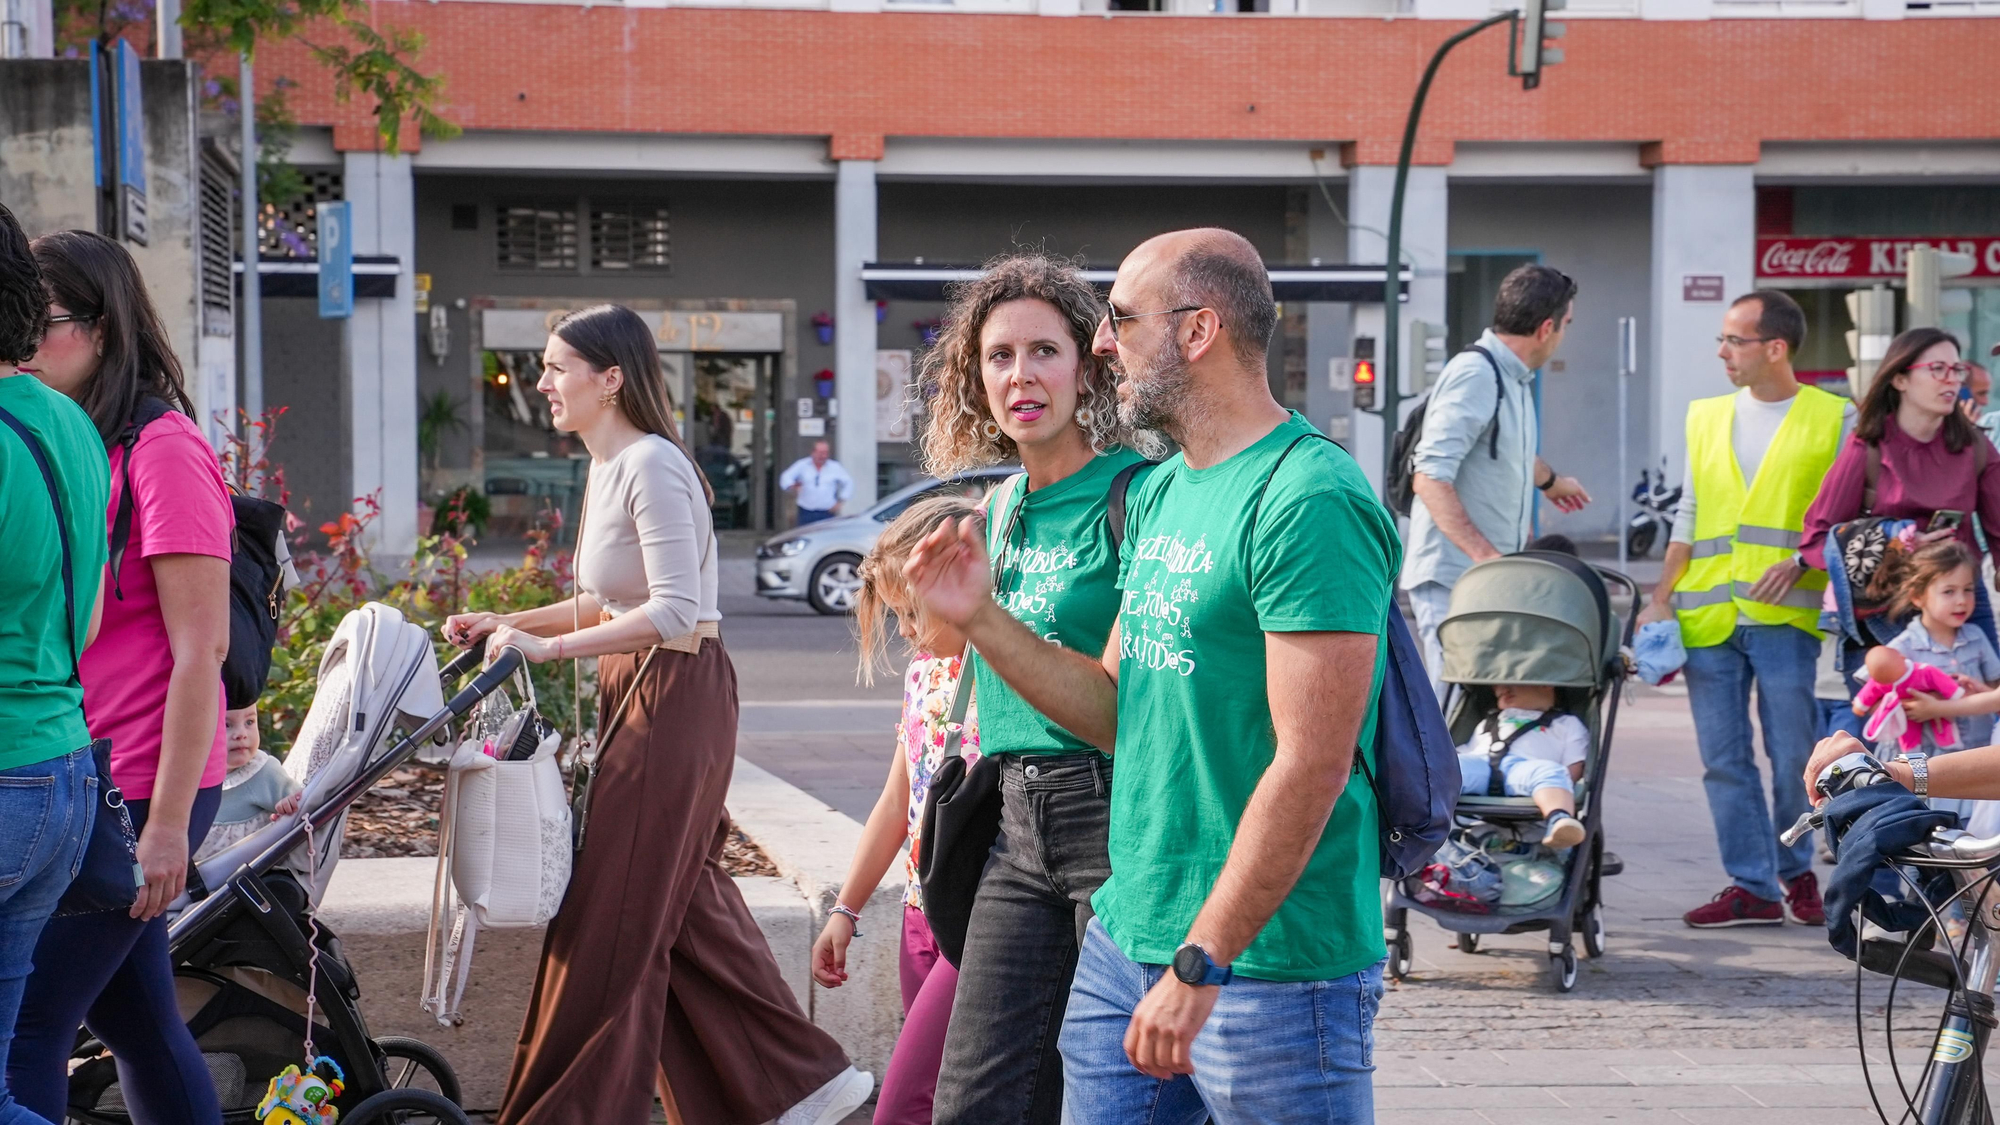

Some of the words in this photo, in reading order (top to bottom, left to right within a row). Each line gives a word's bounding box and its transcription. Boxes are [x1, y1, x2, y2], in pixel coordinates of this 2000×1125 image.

[325, 216, 340, 263] P
[1134, 535, 1177, 567] SCUELA
[1119, 636, 1140, 661] ARA
[1142, 638, 1196, 676] TOD@S
